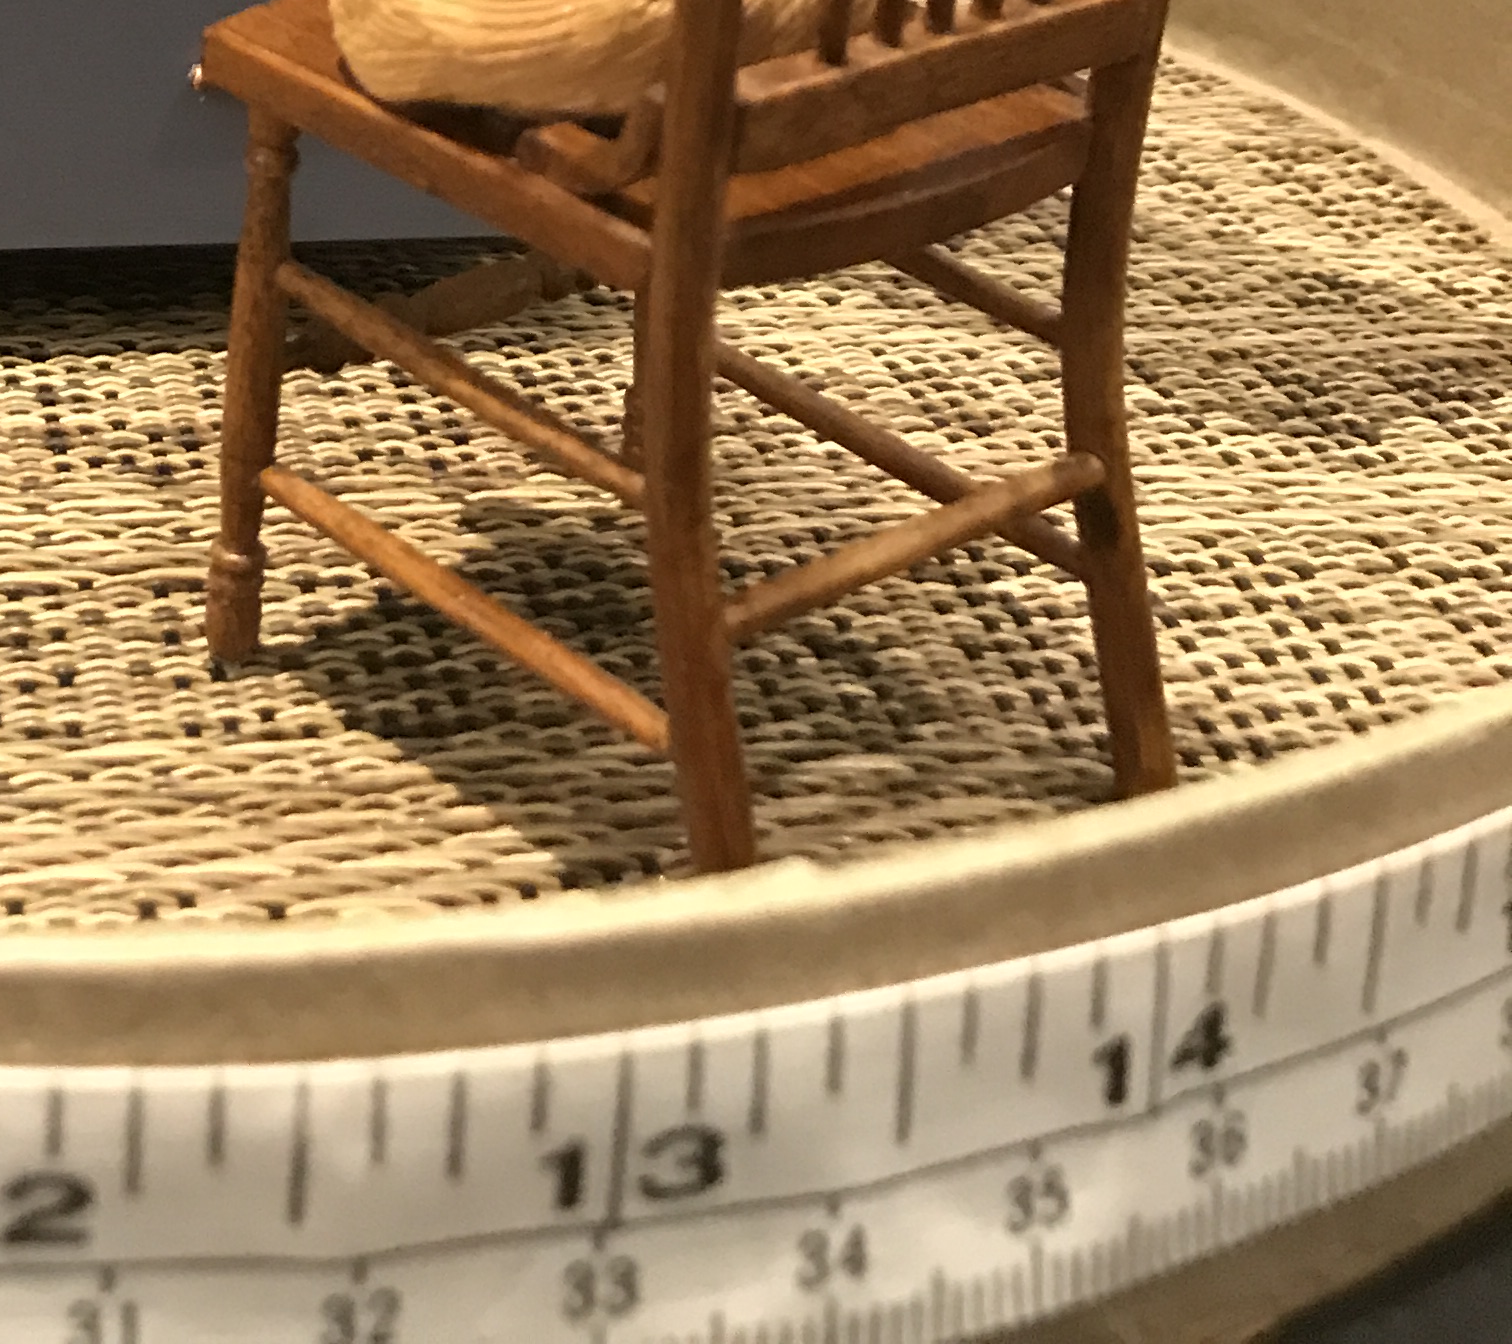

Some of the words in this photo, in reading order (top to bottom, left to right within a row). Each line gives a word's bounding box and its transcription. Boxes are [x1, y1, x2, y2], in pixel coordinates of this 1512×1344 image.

[538, 1124, 728, 1210] 13
[1092, 1002, 1232, 1108] 14
[562, 1254, 640, 1316] 33
[798, 1226, 868, 1292] 34
[1006, 1168, 1070, 1236] 35
[1188, 1116, 1248, 1176] 36
[1356, 1046, 1410, 1116] 37
